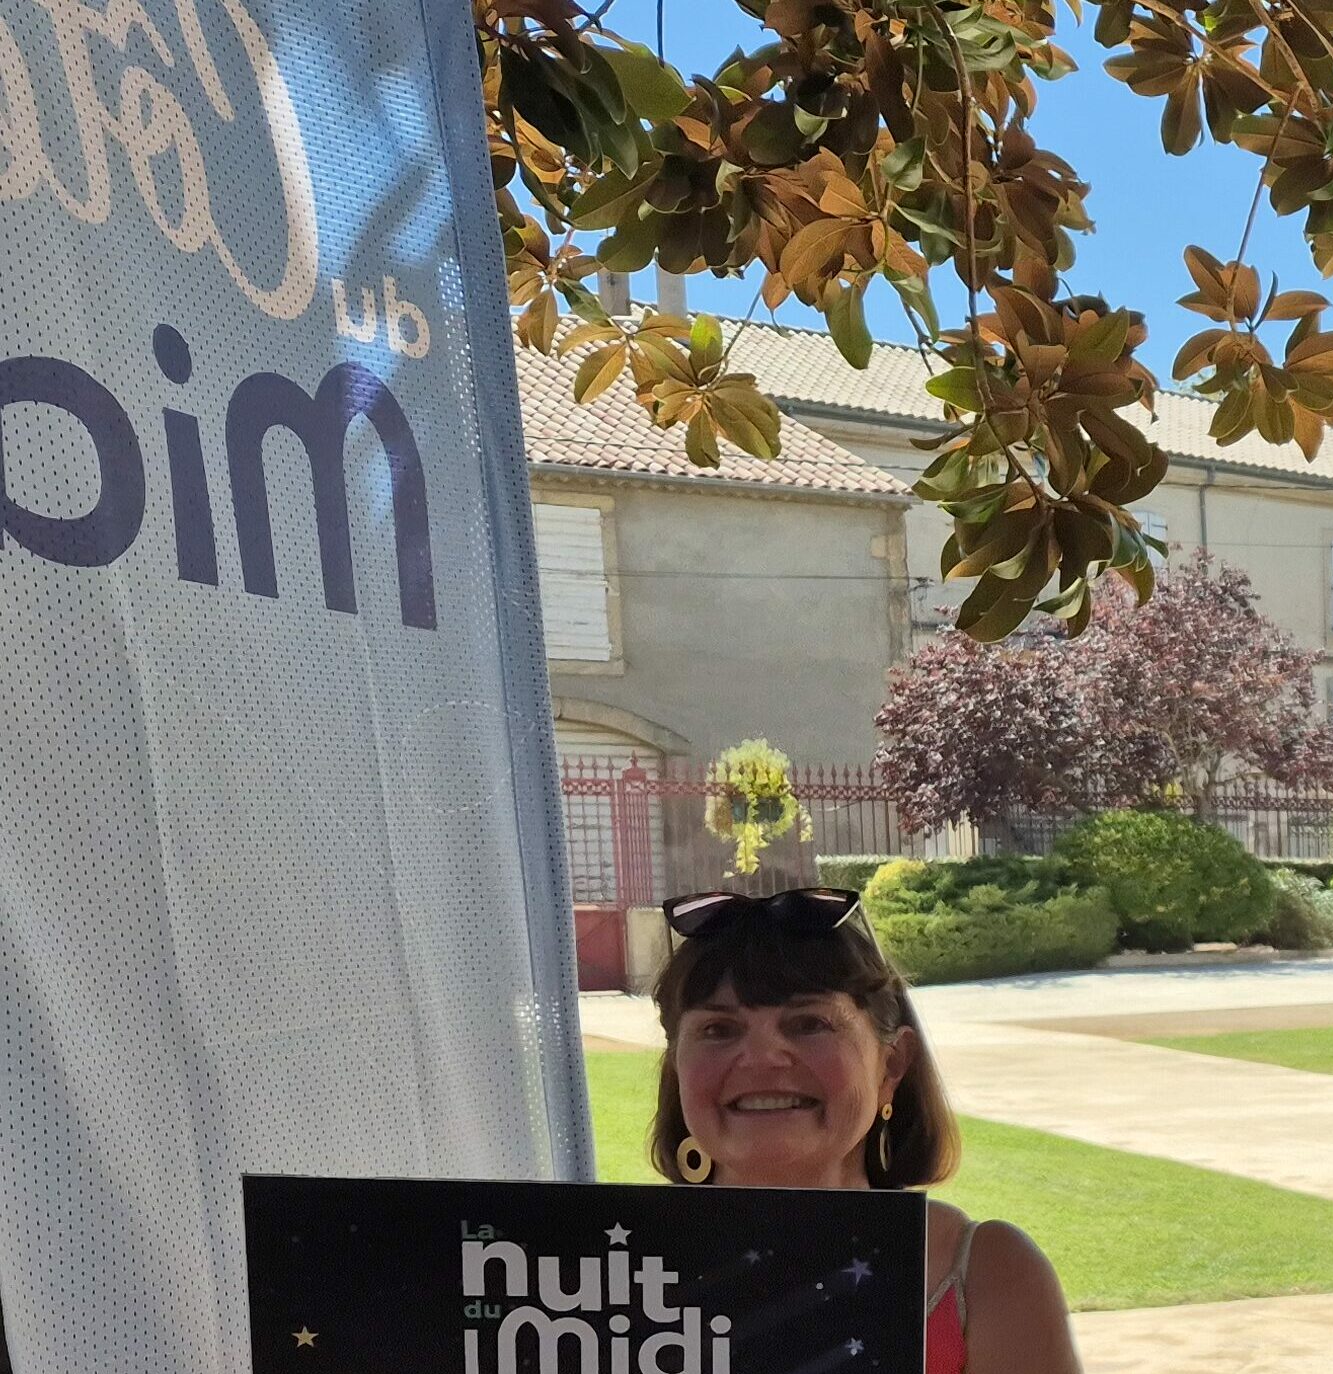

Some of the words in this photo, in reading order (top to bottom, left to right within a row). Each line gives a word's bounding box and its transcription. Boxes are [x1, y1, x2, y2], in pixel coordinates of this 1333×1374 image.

[461, 1219, 495, 1240] La
[461, 1222, 681, 1324] nuit
[463, 1299, 501, 1319] du
